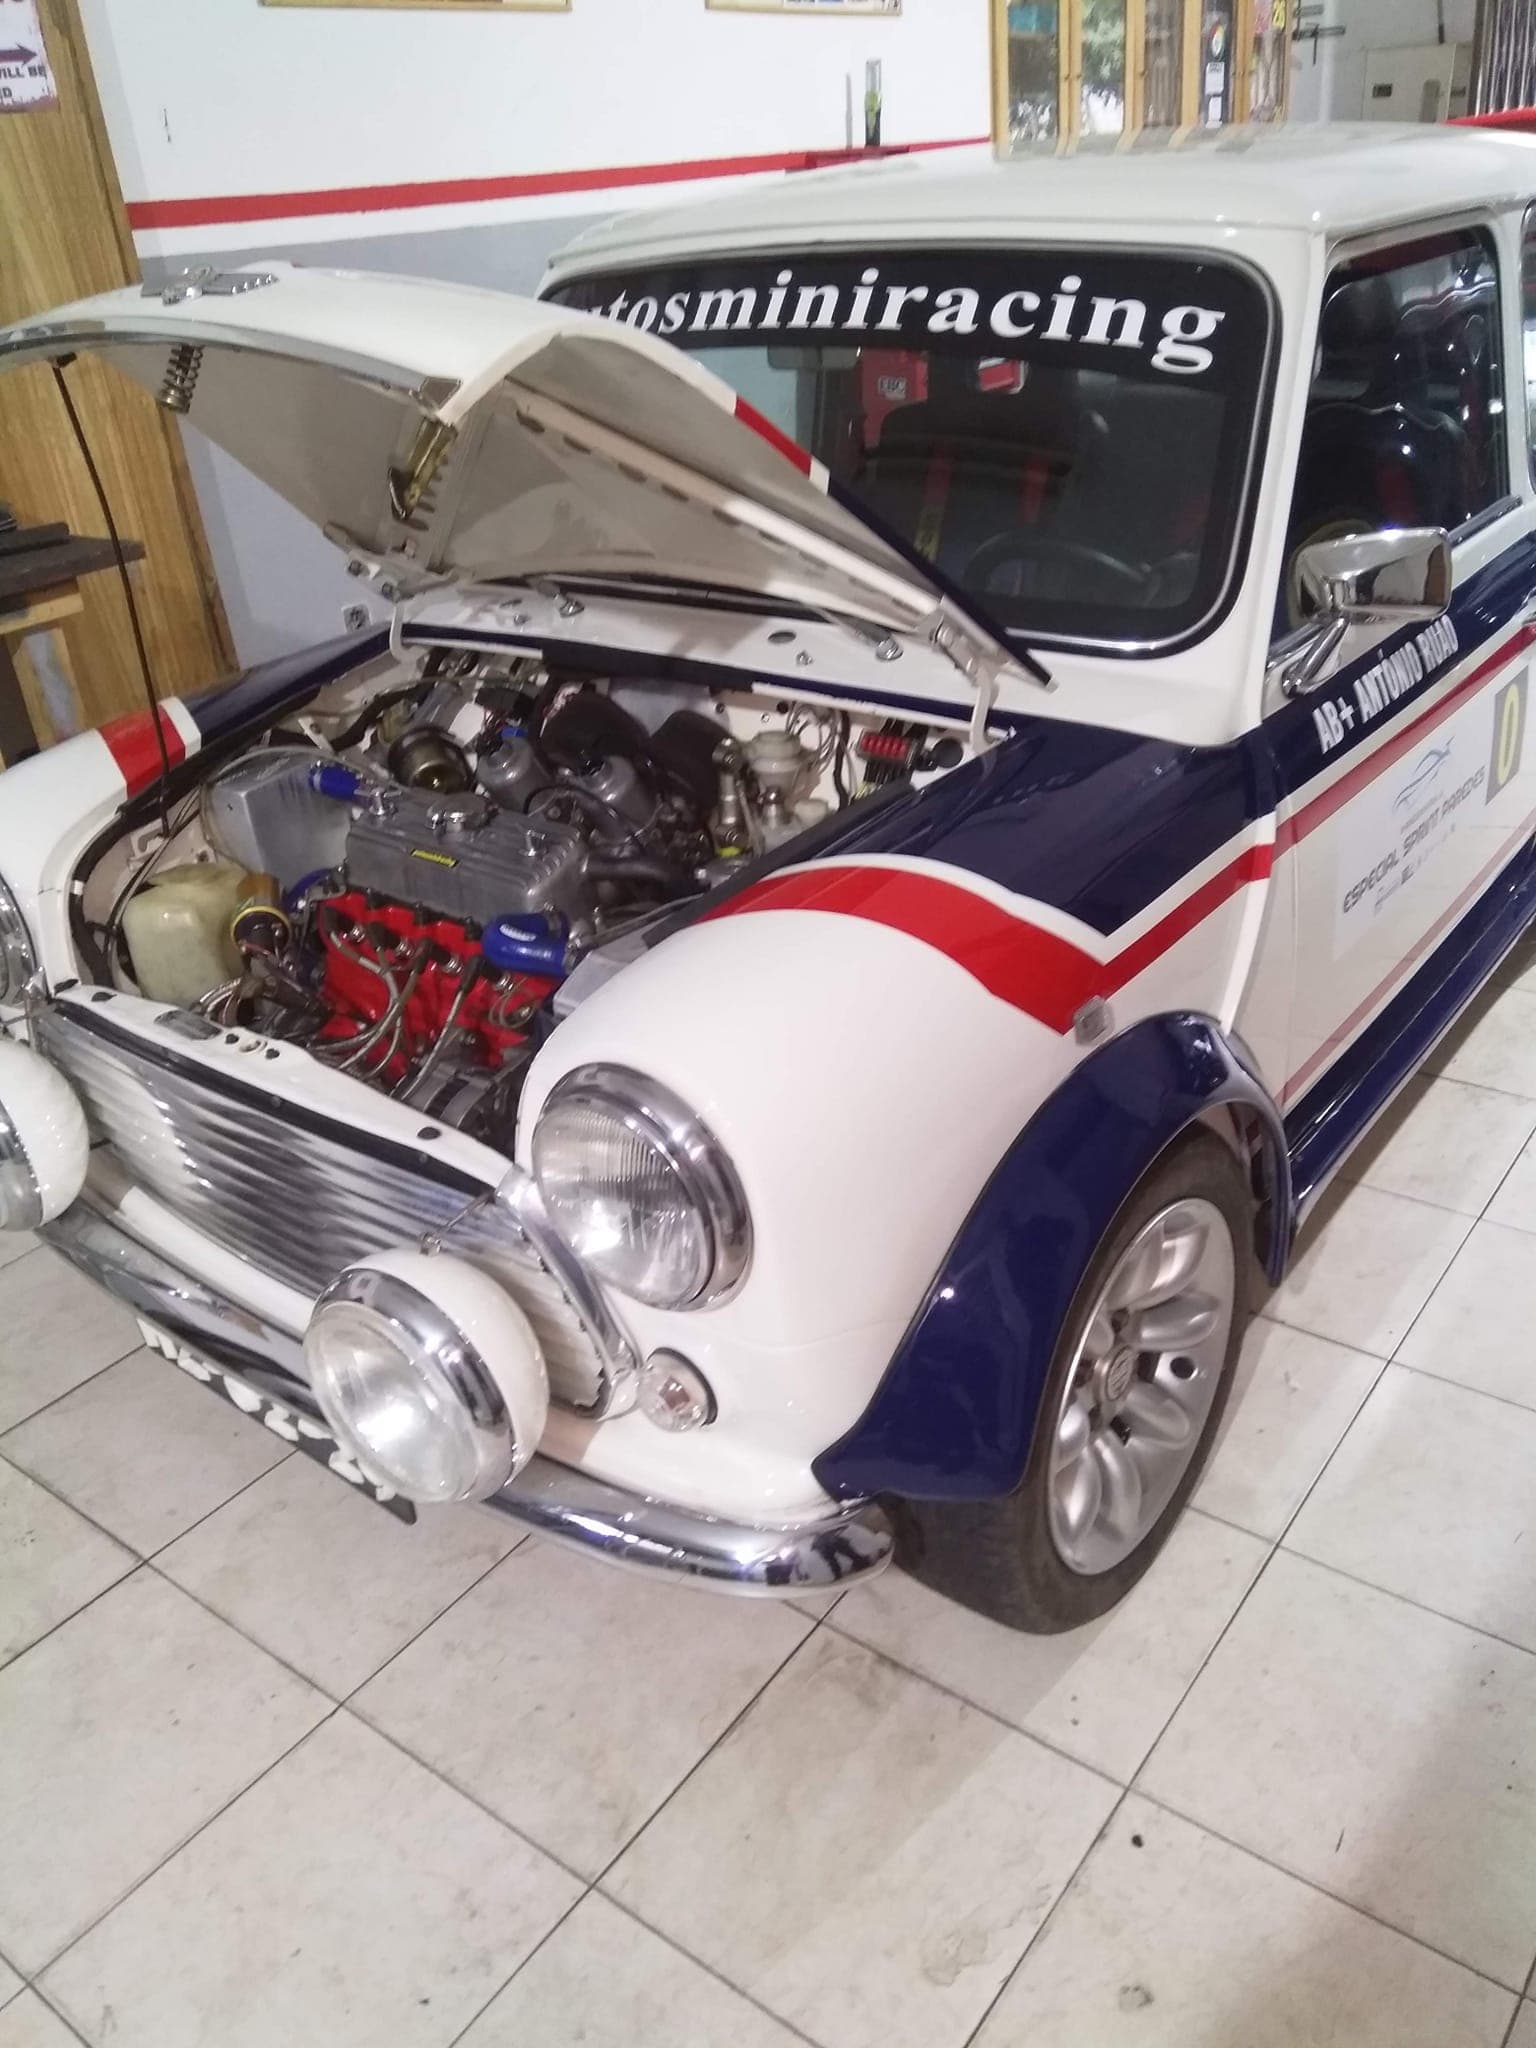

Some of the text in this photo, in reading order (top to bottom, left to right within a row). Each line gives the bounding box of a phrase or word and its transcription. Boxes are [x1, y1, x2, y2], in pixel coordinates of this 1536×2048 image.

[1312, 696, 1355, 754] AB+
[1353, 648, 1424, 724] ANTÓNIO
[1342, 848, 1400, 914] ESPECIAL
[1401, 806, 1441, 858] SPRINT
[1440, 764, 1486, 822] PAREDES
